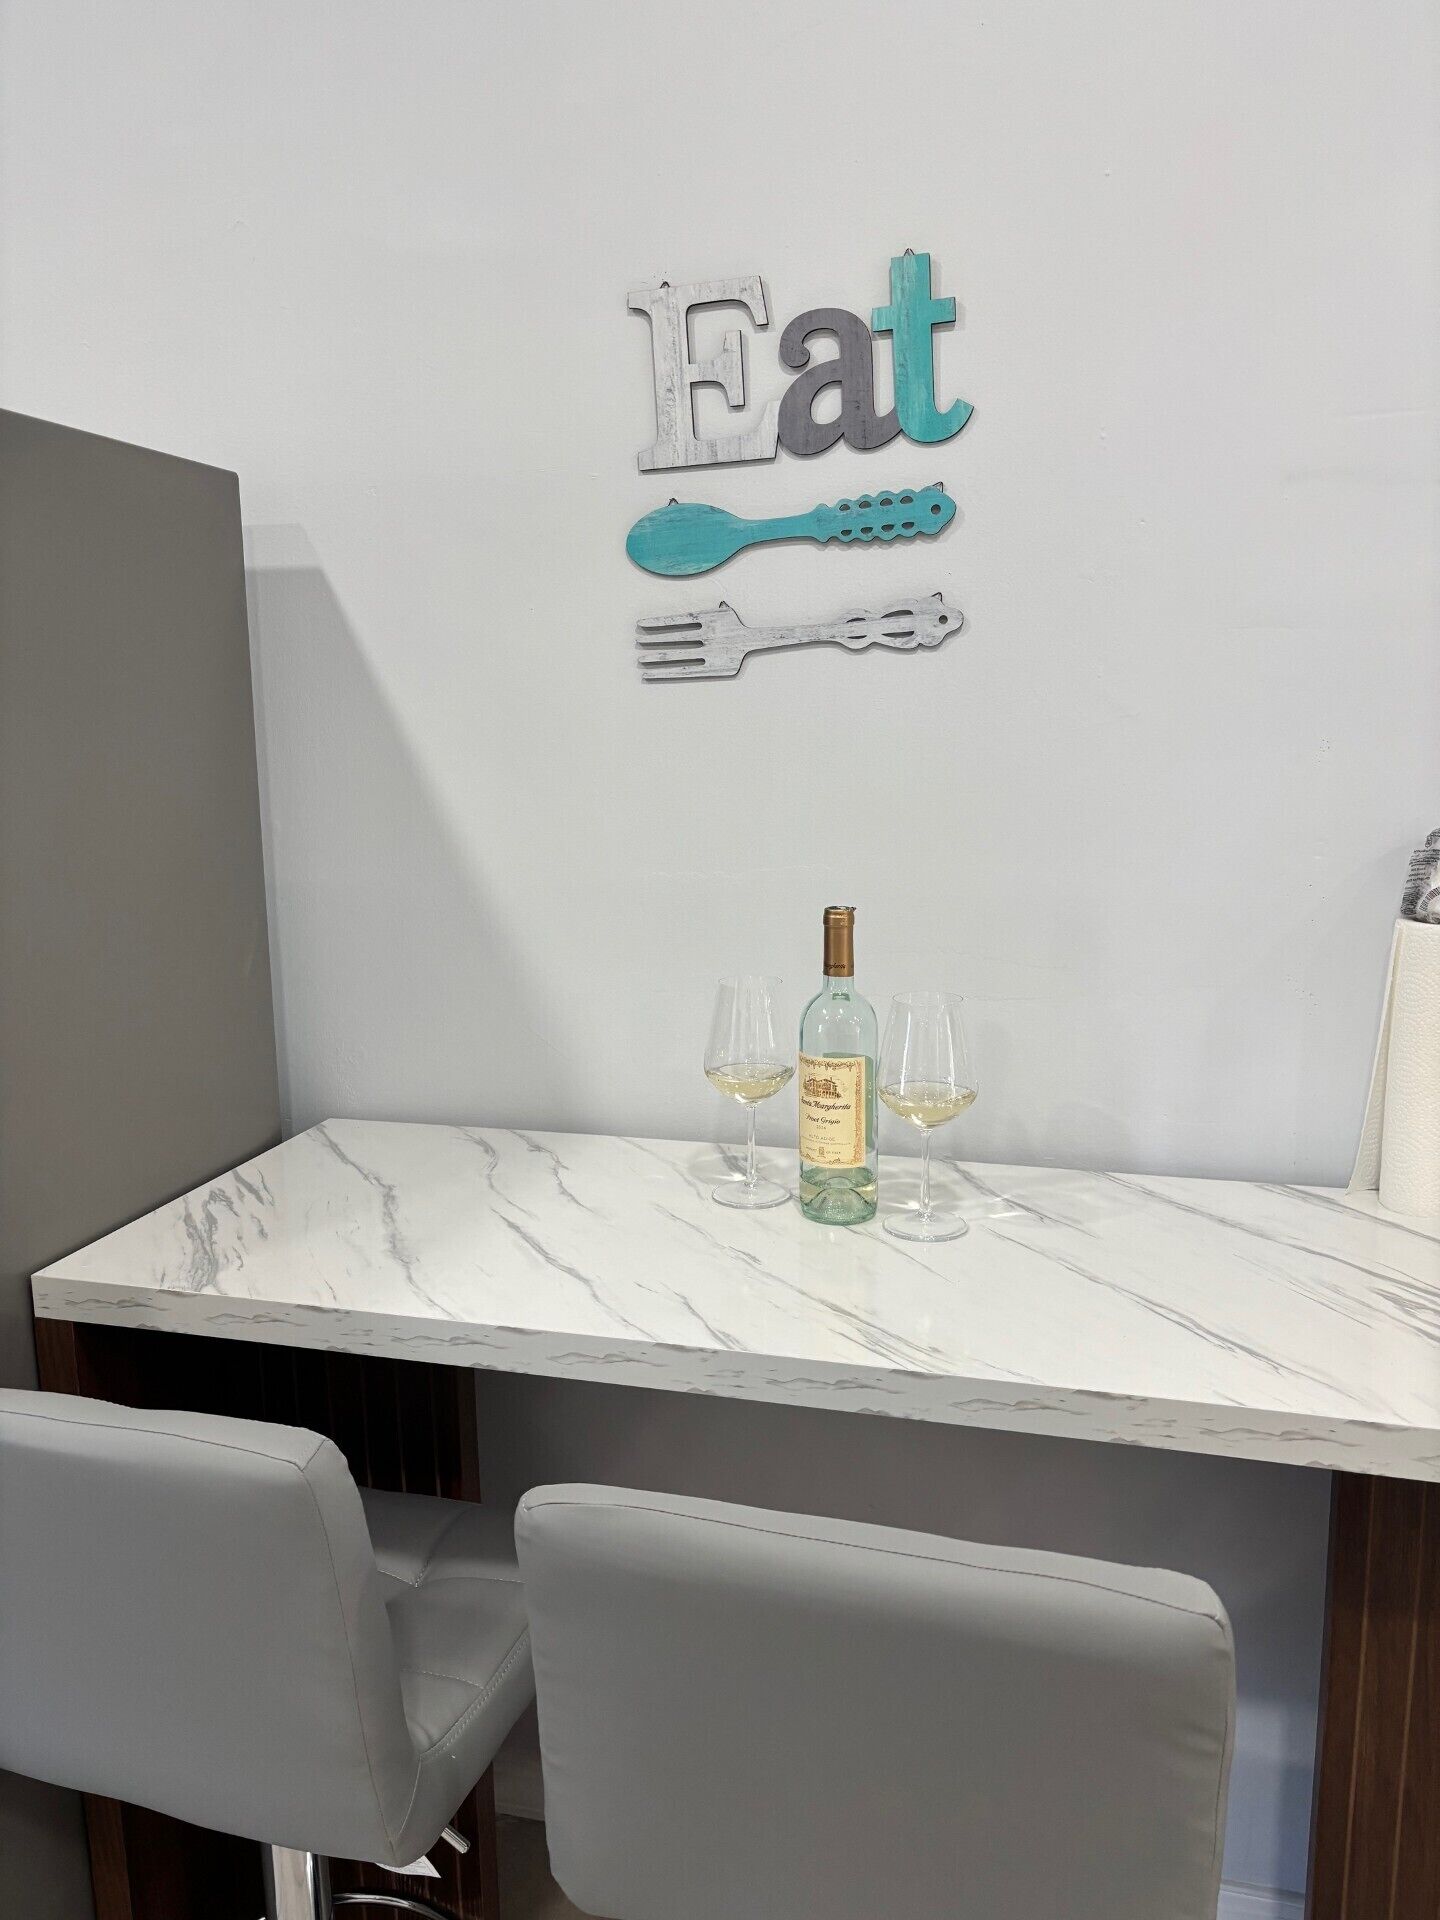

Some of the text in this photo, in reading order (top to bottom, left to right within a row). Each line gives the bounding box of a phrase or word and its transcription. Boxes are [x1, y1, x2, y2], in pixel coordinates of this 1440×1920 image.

[627, 252, 975, 472] Eat
[812, 1101, 851, 1112] Margherita
[820, 1117, 841, 1125] Grigio
